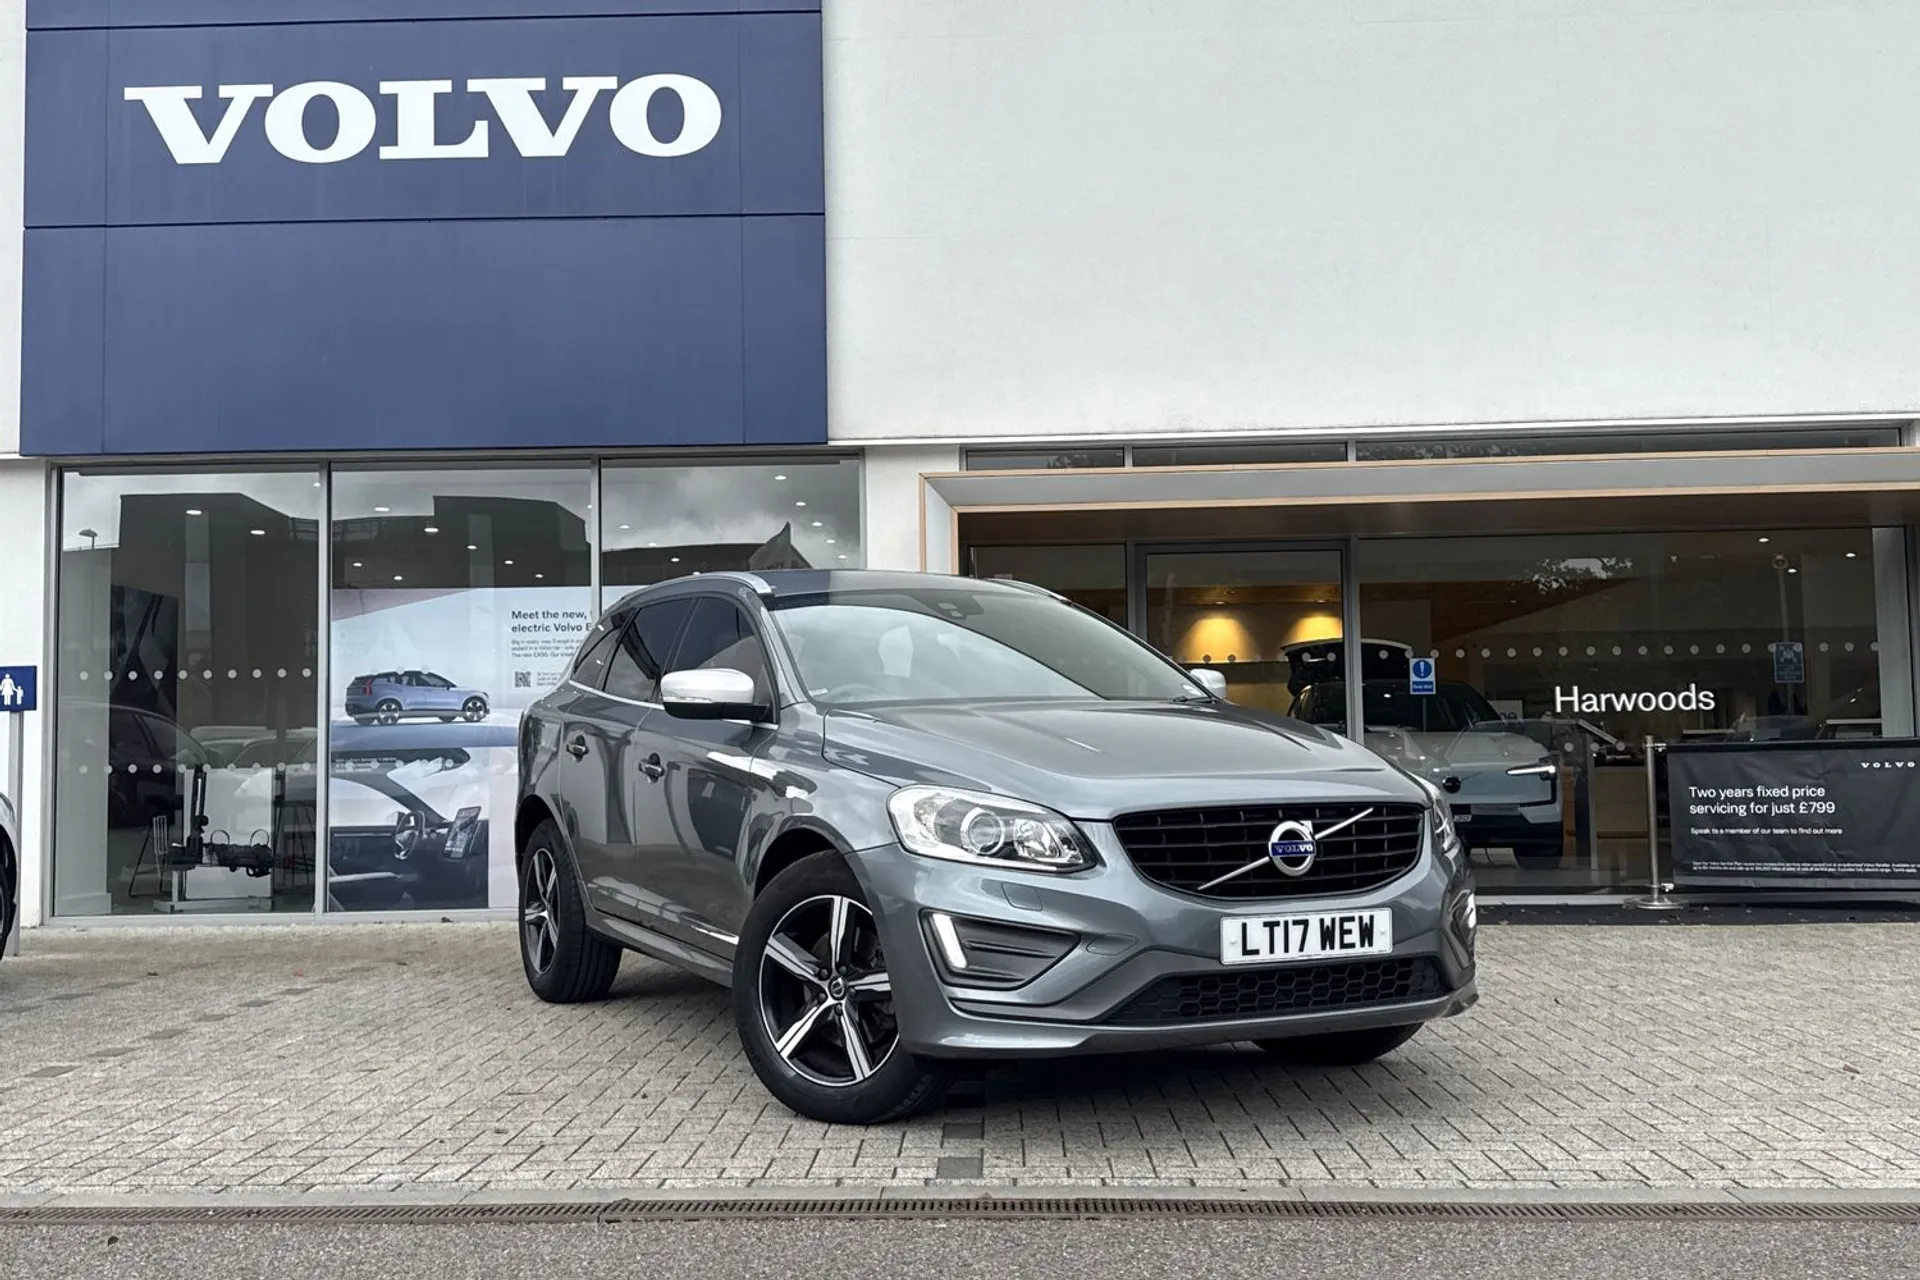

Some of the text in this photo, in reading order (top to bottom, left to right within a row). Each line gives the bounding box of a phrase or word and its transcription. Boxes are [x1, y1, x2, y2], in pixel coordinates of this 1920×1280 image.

[123, 73, 722, 165] VOLVO
[511, 610, 588, 620] Meet the new,
[511, 623, 552, 633] electric
[553, 623, 583, 632] Volvo
[1554, 683, 1716, 713] Harwoods
[1860, 761, 1916, 769] VOLVO
[1688, 785, 1826, 800] Two years fixed price
[1689, 801, 1836, 817] servicing for just £799
[1690, 827, 1710, 835] Speak
[1711, 827, 1718, 835] to
[1724, 827, 1751, 835] member
[1752, 827, 1760, 835] of
[1760, 827, 1771, 835] our
[1772, 827, 1789, 835] team
[1790, 827, 1797, 835] to
[1798, 827, 1811, 835] find
[1812, 827, 1824, 835] out
[1824, 827, 1843, 835] more
[1273, 844, 1314, 853] VOLVO
[1241, 914, 1376, 956] LT17 WEW
